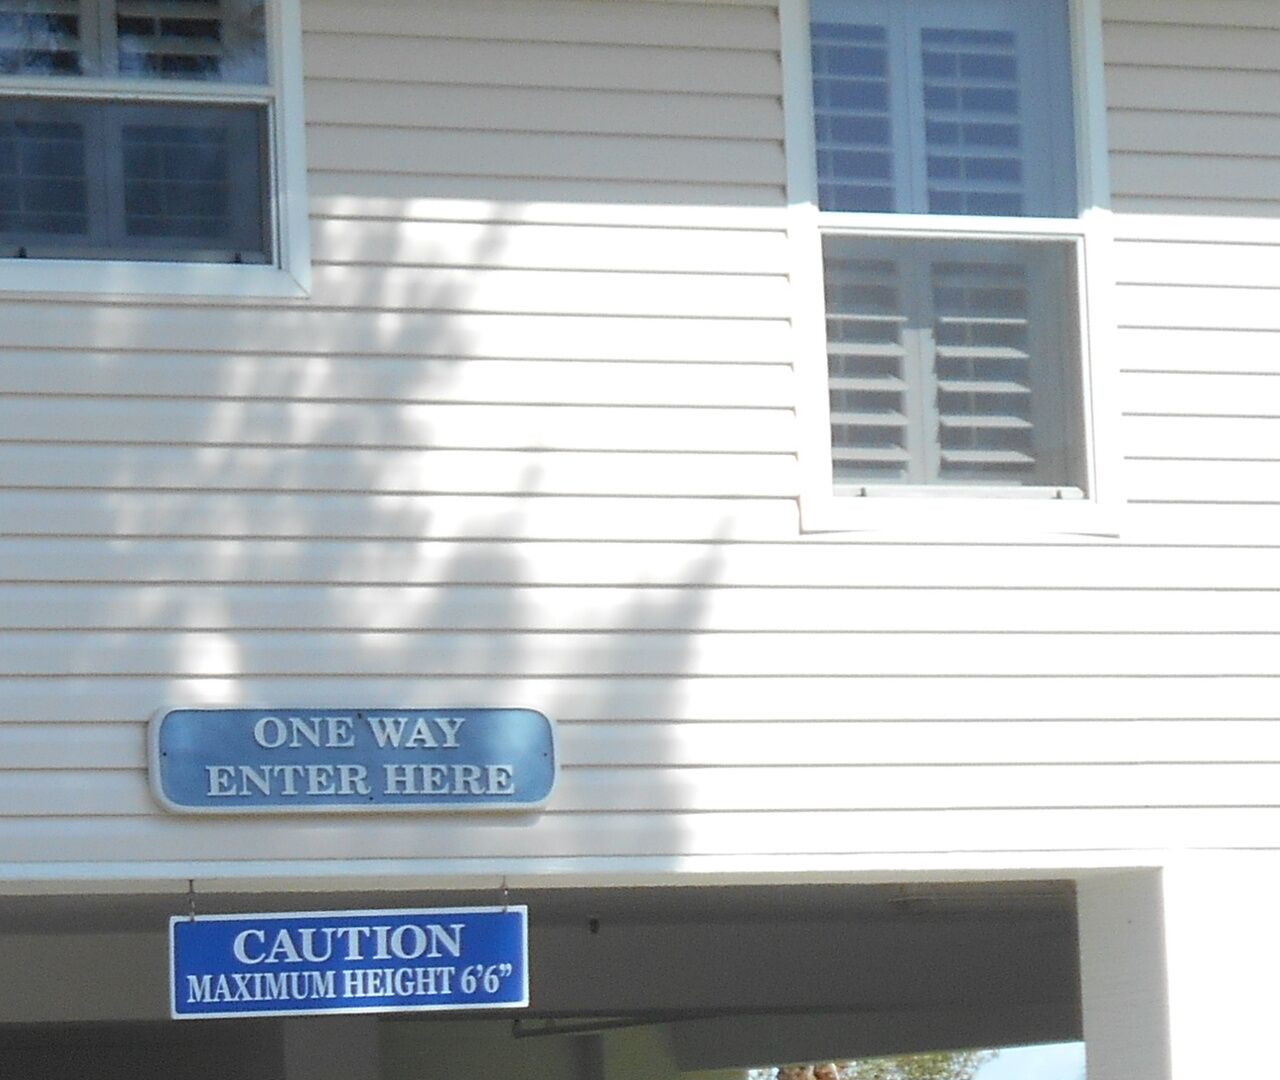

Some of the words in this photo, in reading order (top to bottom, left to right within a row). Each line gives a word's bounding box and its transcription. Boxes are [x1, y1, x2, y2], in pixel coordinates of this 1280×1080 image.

[253, 716, 355, 749] ONE
[368, 716, 466, 749] WAY
[205, 764, 371, 797] ENTER
[383, 763, 515, 796] HERE
[233, 923, 466, 965] CAUTION
[186, 970, 338, 1004] MAXIMUM
[343, 965, 456, 998] HEIGHT
